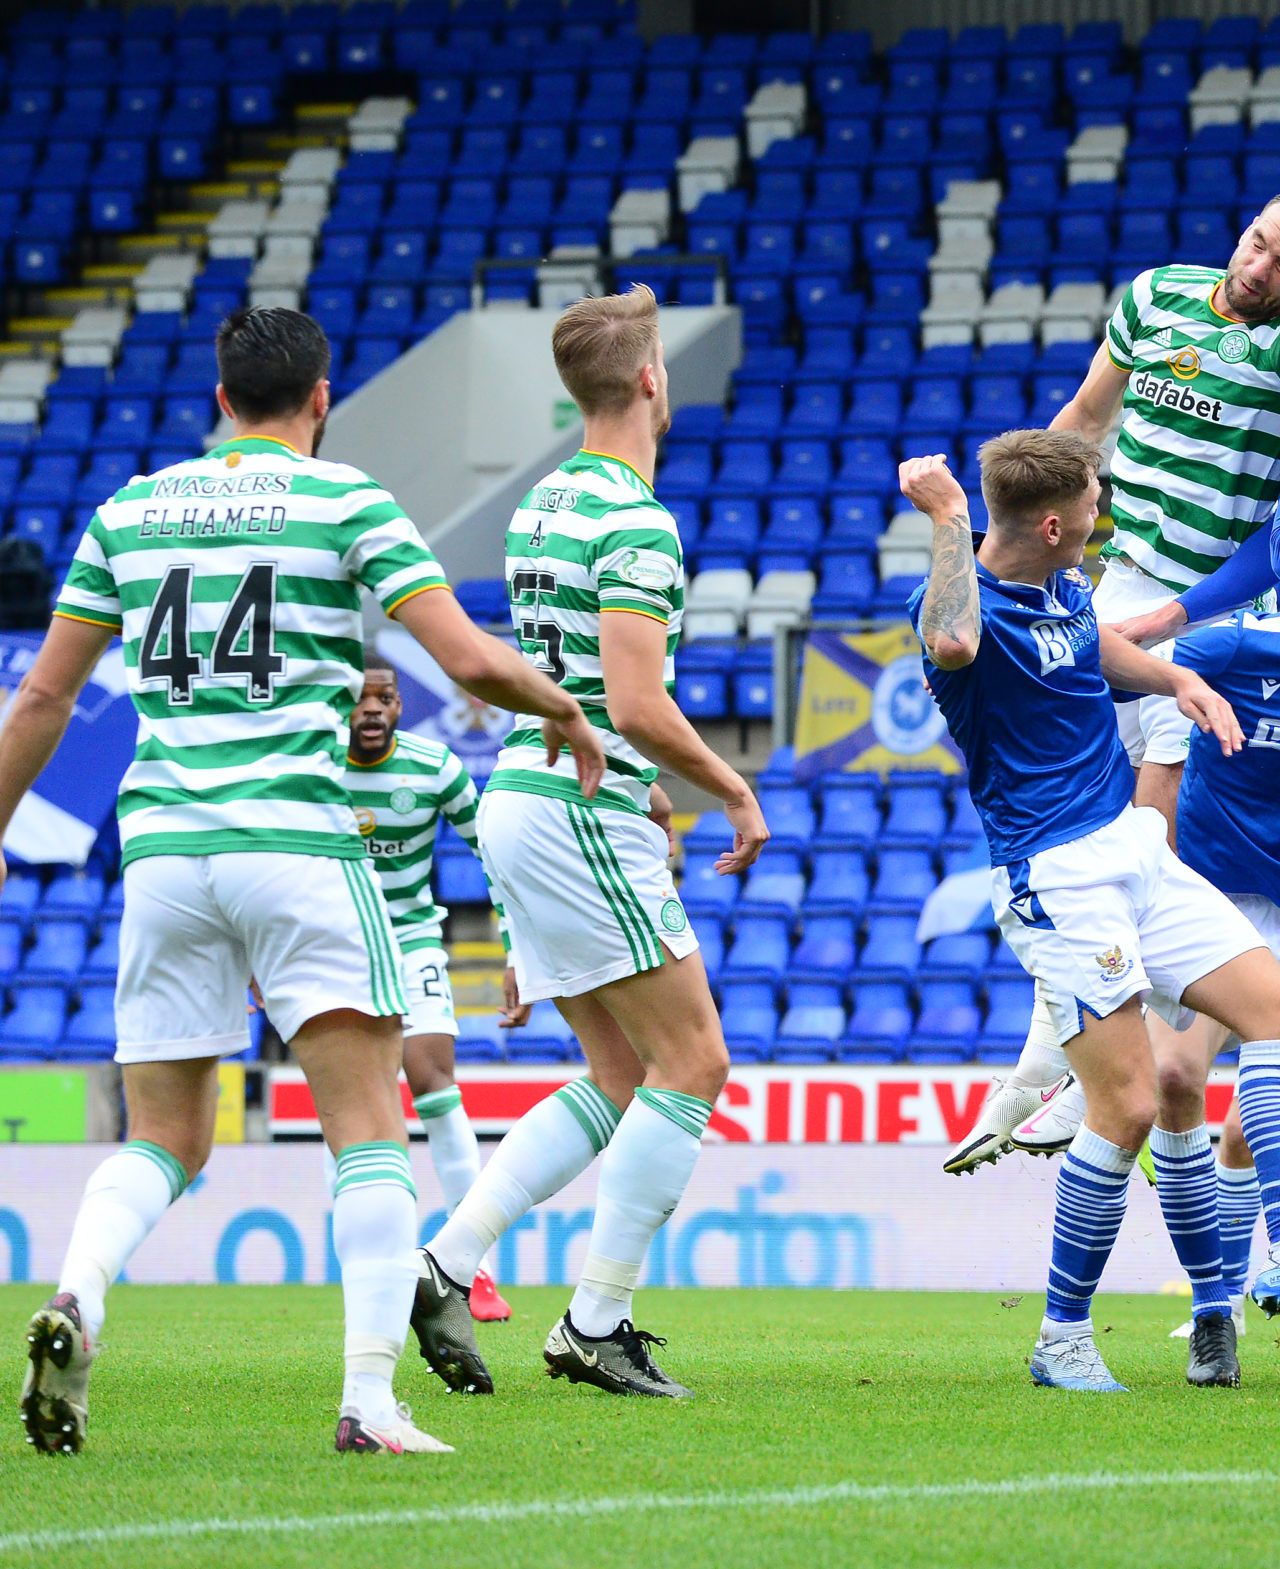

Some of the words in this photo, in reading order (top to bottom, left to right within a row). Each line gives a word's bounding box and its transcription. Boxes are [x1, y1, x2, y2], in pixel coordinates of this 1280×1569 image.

[1135, 373, 1222, 421] dafabet
[155, 474, 291, 497] MAGNERS
[140, 506, 286, 537] ELHAMED
[138, 561, 287, 706] 44
